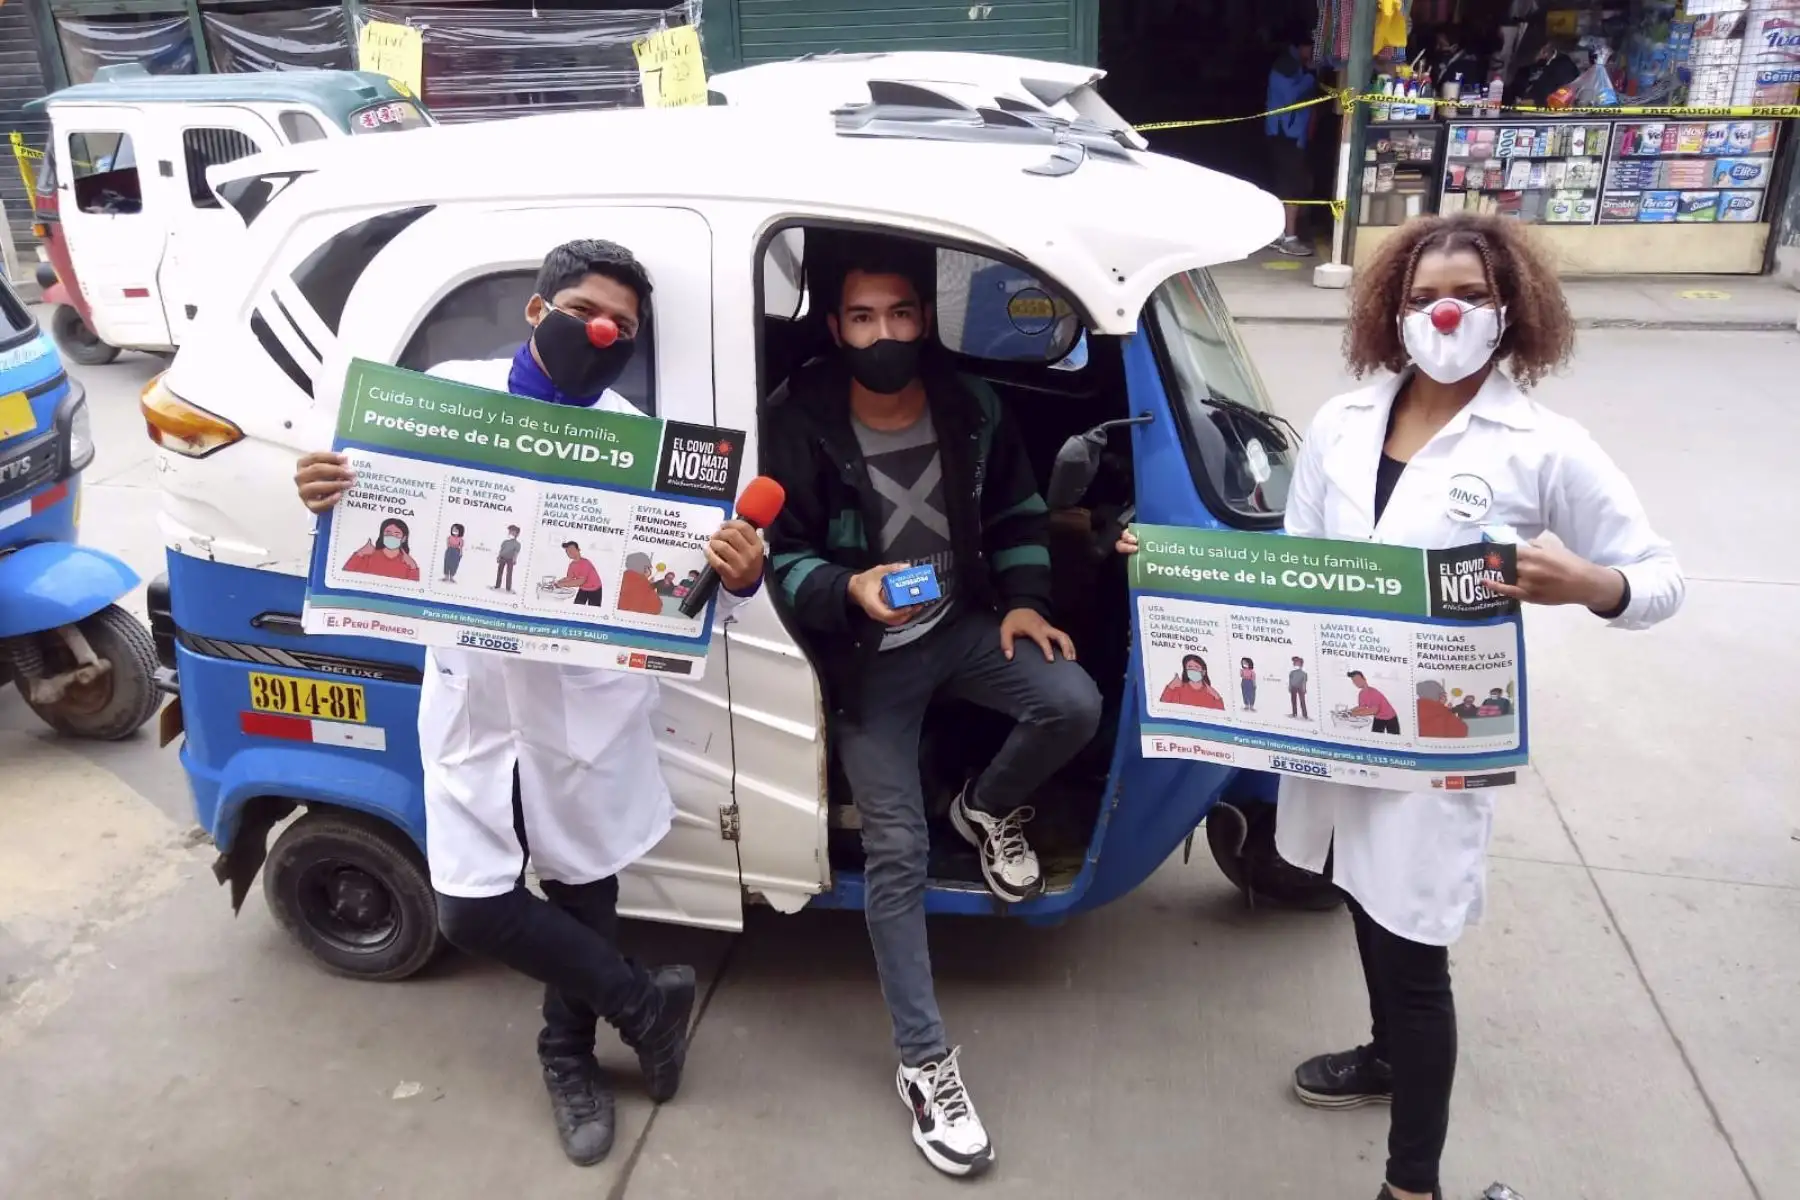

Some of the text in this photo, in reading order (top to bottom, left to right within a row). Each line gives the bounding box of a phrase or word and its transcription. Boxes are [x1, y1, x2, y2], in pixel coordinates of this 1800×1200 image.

[369, 387, 621, 443] Cuida tu salud y la de tu familia.
[364, 410, 635, 469] Protégete de la COVID-19
[673, 438, 714, 454] EL COVID
[669, 449, 701, 480] NO
[701, 455, 729, 470] MATA
[355, 470, 436, 490] ORRECTAMENTE
[699, 468, 727, 484] SOLO
[348, 490, 406, 506] CUBRIENDO
[448, 495, 513, 513] DE DISTANCIA
[346, 500, 377, 512] NARIZ
[387, 506, 415, 517] BOCA
[543, 511, 570, 520] AGUA
[544, 502, 602, 514] MANOS CON
[637, 505, 681, 518] EVITA LAS
[541, 519, 625, 536] FRECUENTEMENTE
[635, 514, 688, 529] REUNIONES
[634, 525, 685, 539] FAMILIARES
[694, 533, 710, 542] LAS
[1145, 541, 1382, 571] Cuida tu salud y la de tu familia.
[1440, 558, 1484, 575] EL COVID
[1146, 562, 1402, 596] Protégete de la COVID-19
[1474, 571, 1505, 585] MATA
[1440, 573, 1475, 604] NO
[461, 635, 518, 651] DE TODOS
[1232, 632, 1293, 645] DE DISTANCIA
[1320, 632, 1380, 644] MANOS CON
[1321, 640, 1348, 649] AGUA
[1416, 632, 1465, 643] EVITA LAS
[1417, 642, 1476, 652] REUNIONES
[1321, 648, 1409, 664] FRECUENTEMENTE
[1417, 651, 1477, 661] FAMILIARES
[1487, 651, 1506, 660] LAS
[321, 665, 385, 679] DELUXE
[1417, 660, 1513, 671] AGLOMERACIONES
[254, 676, 363, 720] 3914-8F
[1273, 760, 1327, 776] DE TODOS
